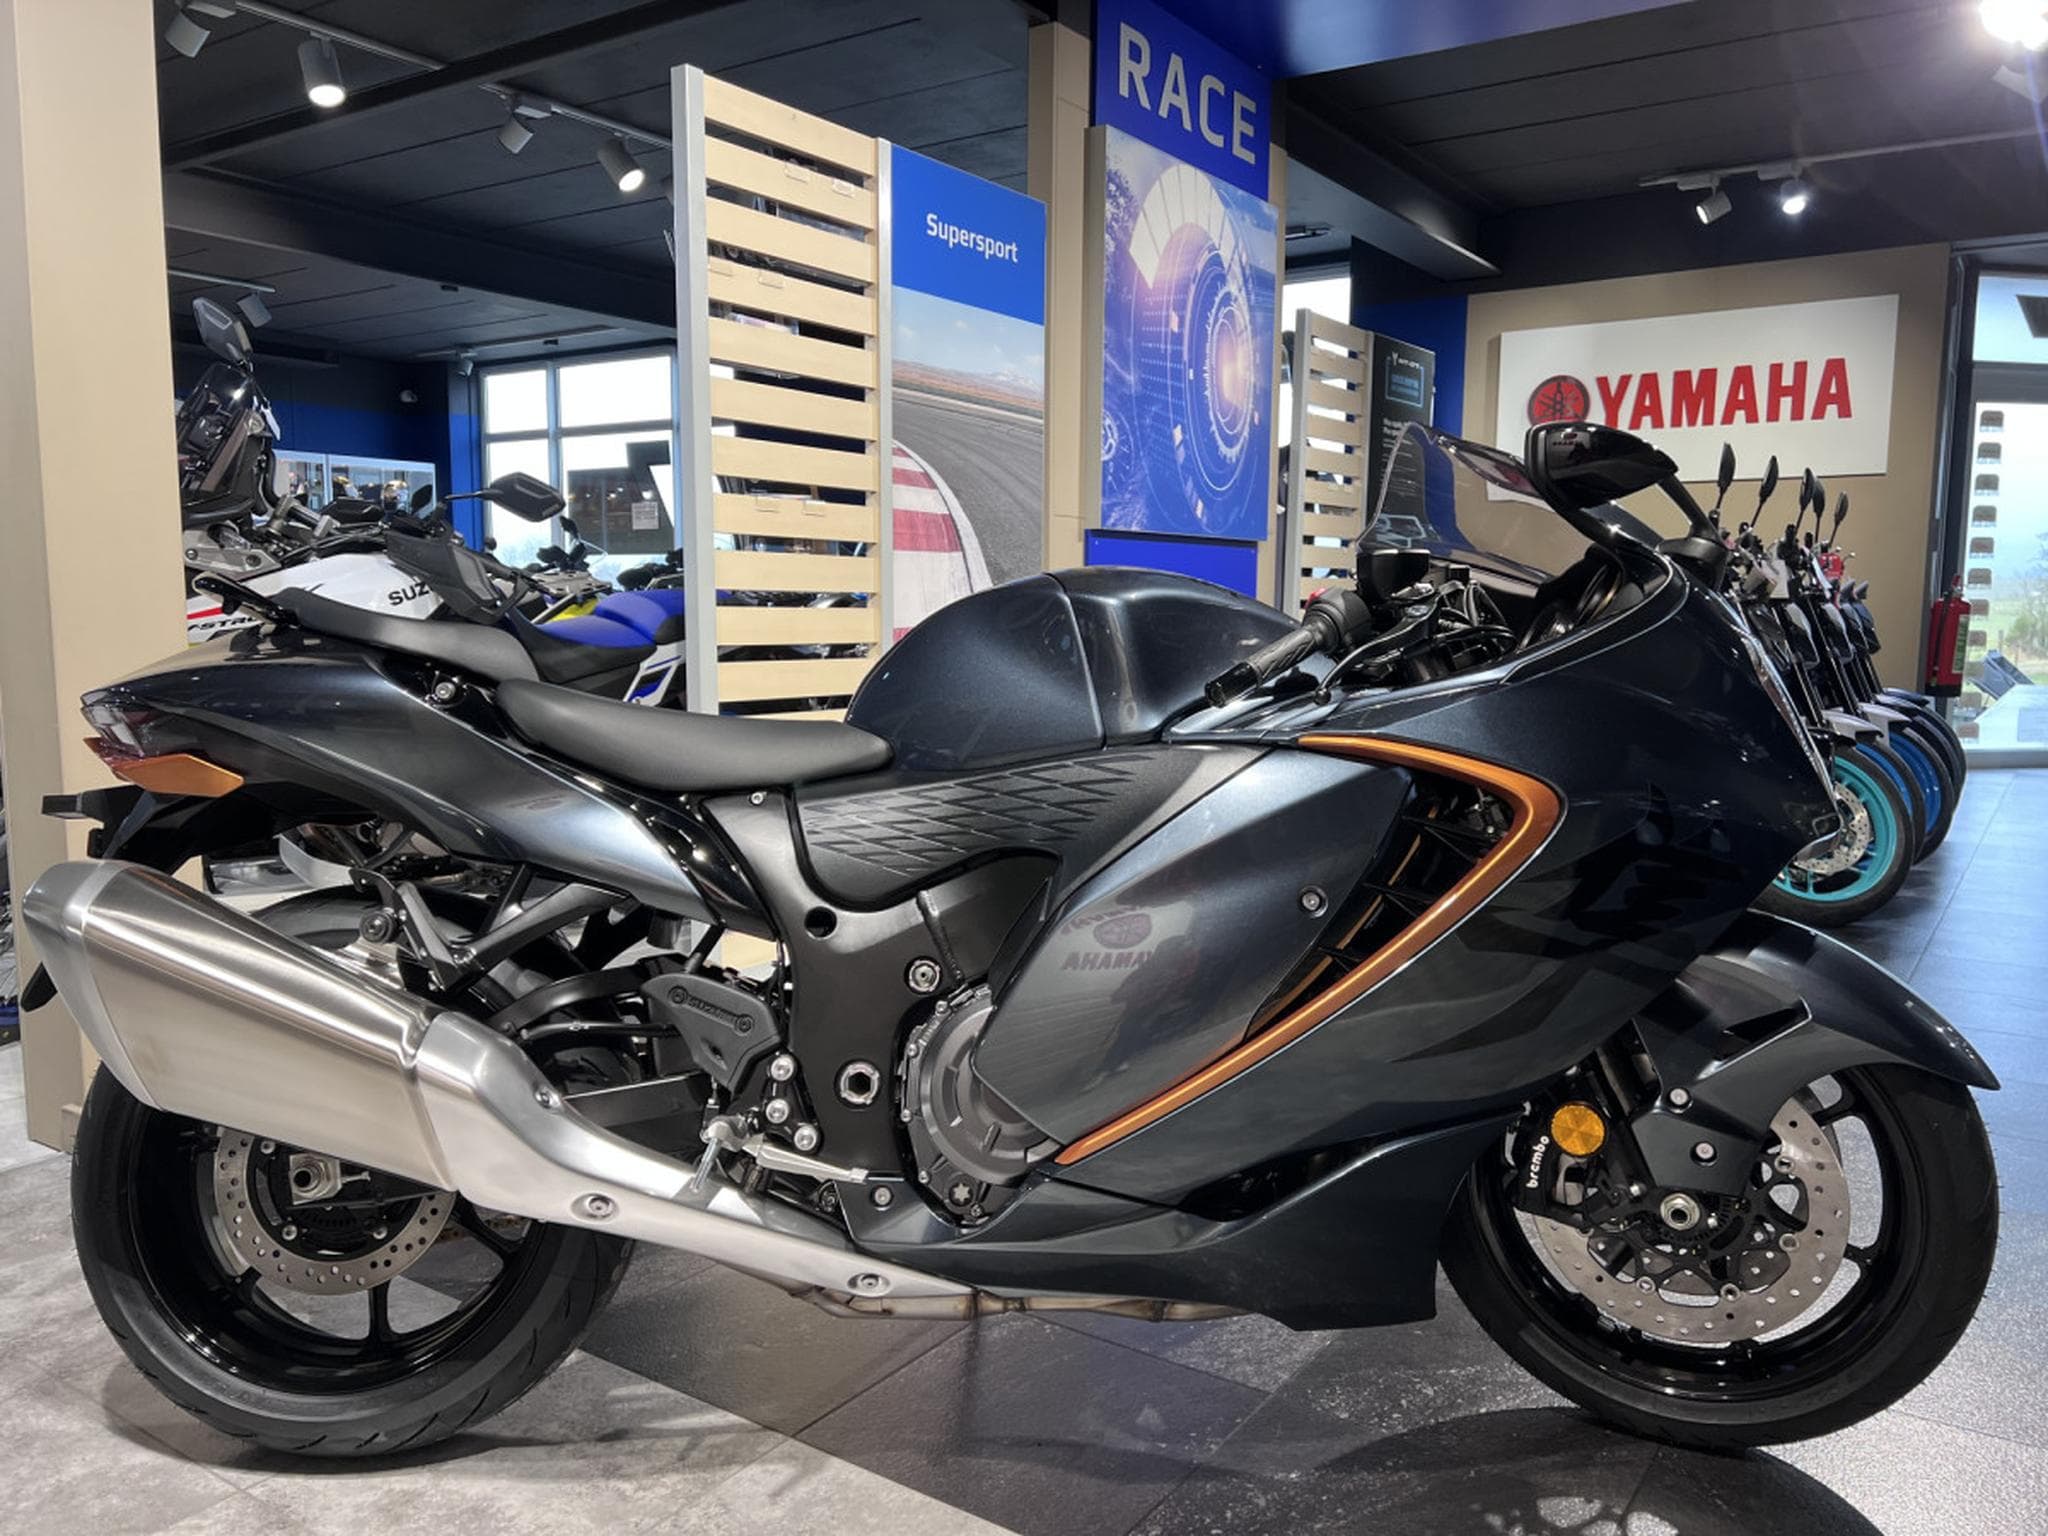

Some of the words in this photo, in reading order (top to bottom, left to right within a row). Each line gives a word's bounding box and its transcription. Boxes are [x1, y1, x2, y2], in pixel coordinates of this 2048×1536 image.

[1119, 21, 1257, 165] RACE
[926, 212, 1019, 263] Supersport
[1596, 358, 1852, 430] YAMAHA
[388, 581, 430, 606] SUZ
[1525, 1136, 1550, 1188] brembo
